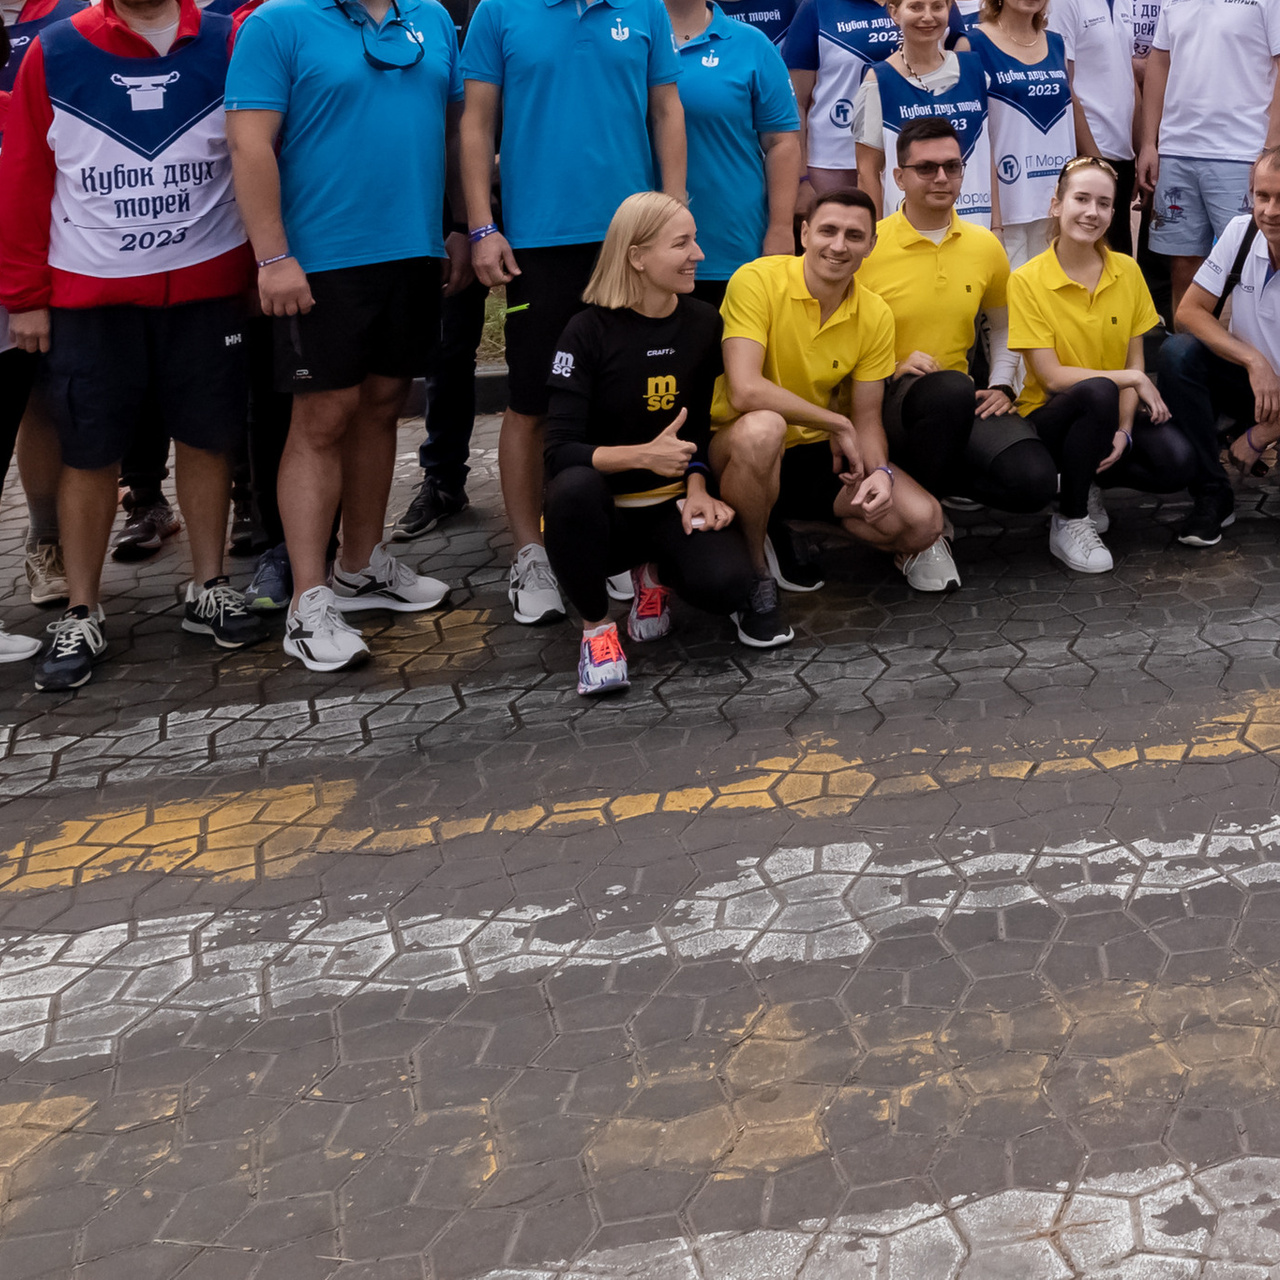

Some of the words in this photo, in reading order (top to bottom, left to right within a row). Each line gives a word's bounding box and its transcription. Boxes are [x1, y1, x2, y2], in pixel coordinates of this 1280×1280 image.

[836, 19, 869, 33] Кубок
[871, 17, 896, 30] двух
[996, 71, 1026, 85] Кубок
[1028, 70, 1049, 82] двух
[1027, 83, 1061, 97] 2023
[900, 103, 932, 119] Кубок
[934, 101, 957, 115] двух
[80, 163, 155, 196] Кубок
[162, 160, 216, 189] двух
[118, 226, 190, 252] 2023
[224, 333, 242, 347] HH
[646, 348, 669, 357] CRAFT
